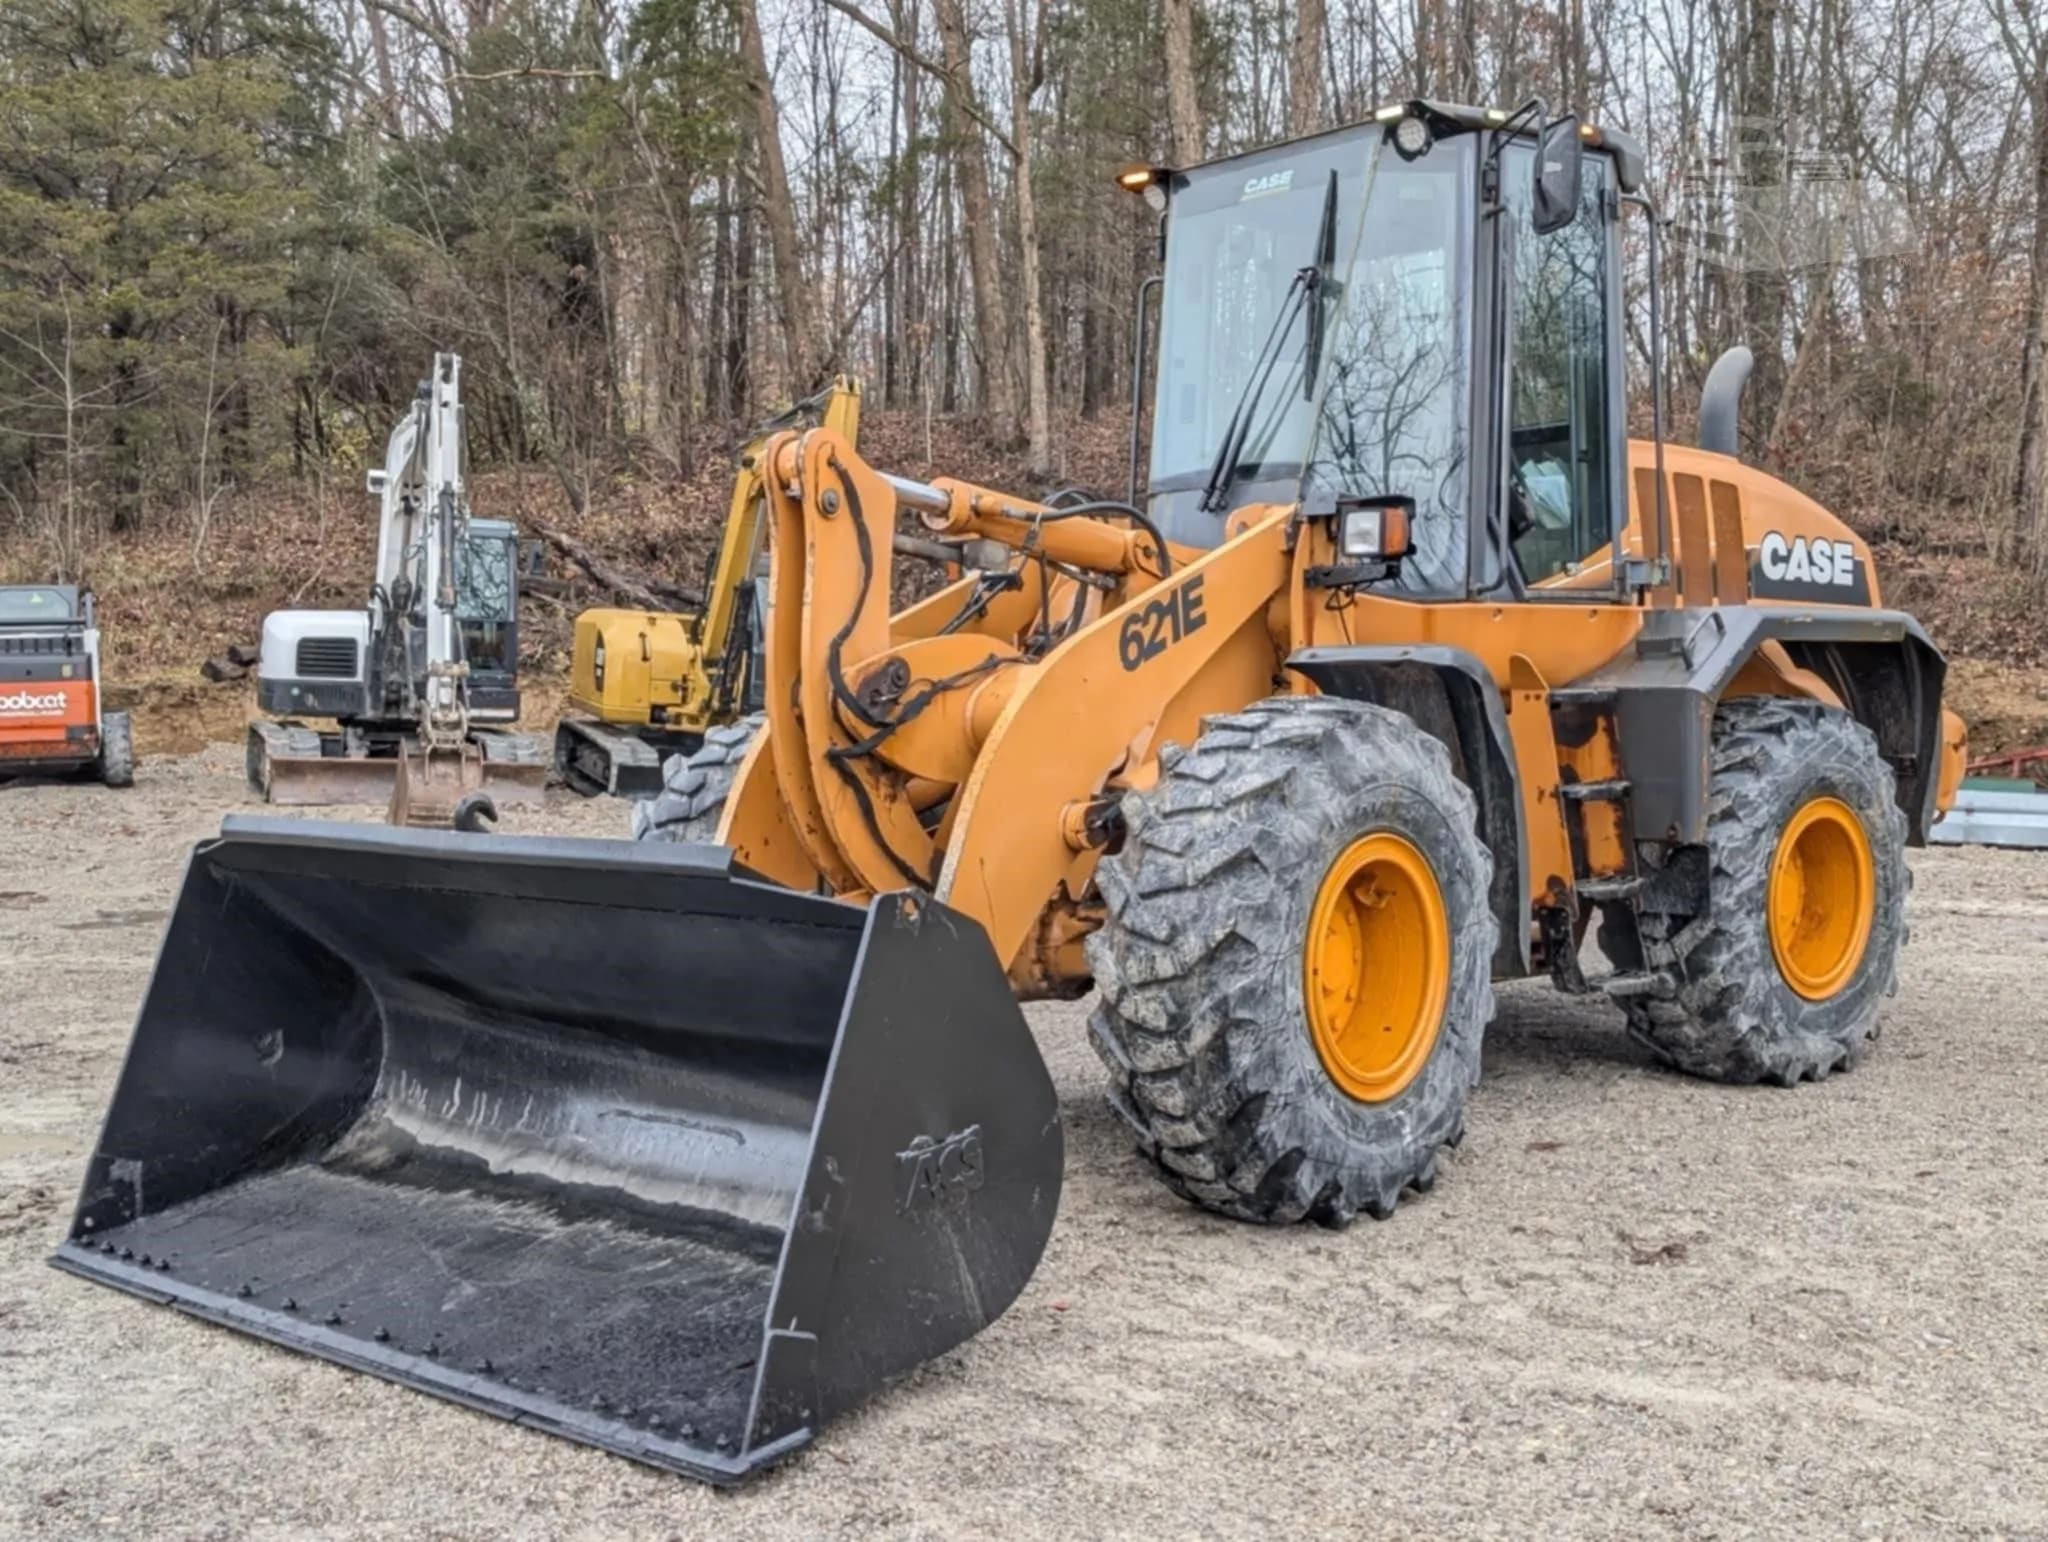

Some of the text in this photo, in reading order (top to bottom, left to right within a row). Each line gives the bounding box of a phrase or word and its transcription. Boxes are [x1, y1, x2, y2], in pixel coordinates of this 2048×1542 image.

[1244, 169, 1295, 193] CASE
[1760, 531, 1854, 587] CASE
[1119, 573, 1207, 672] 621E
